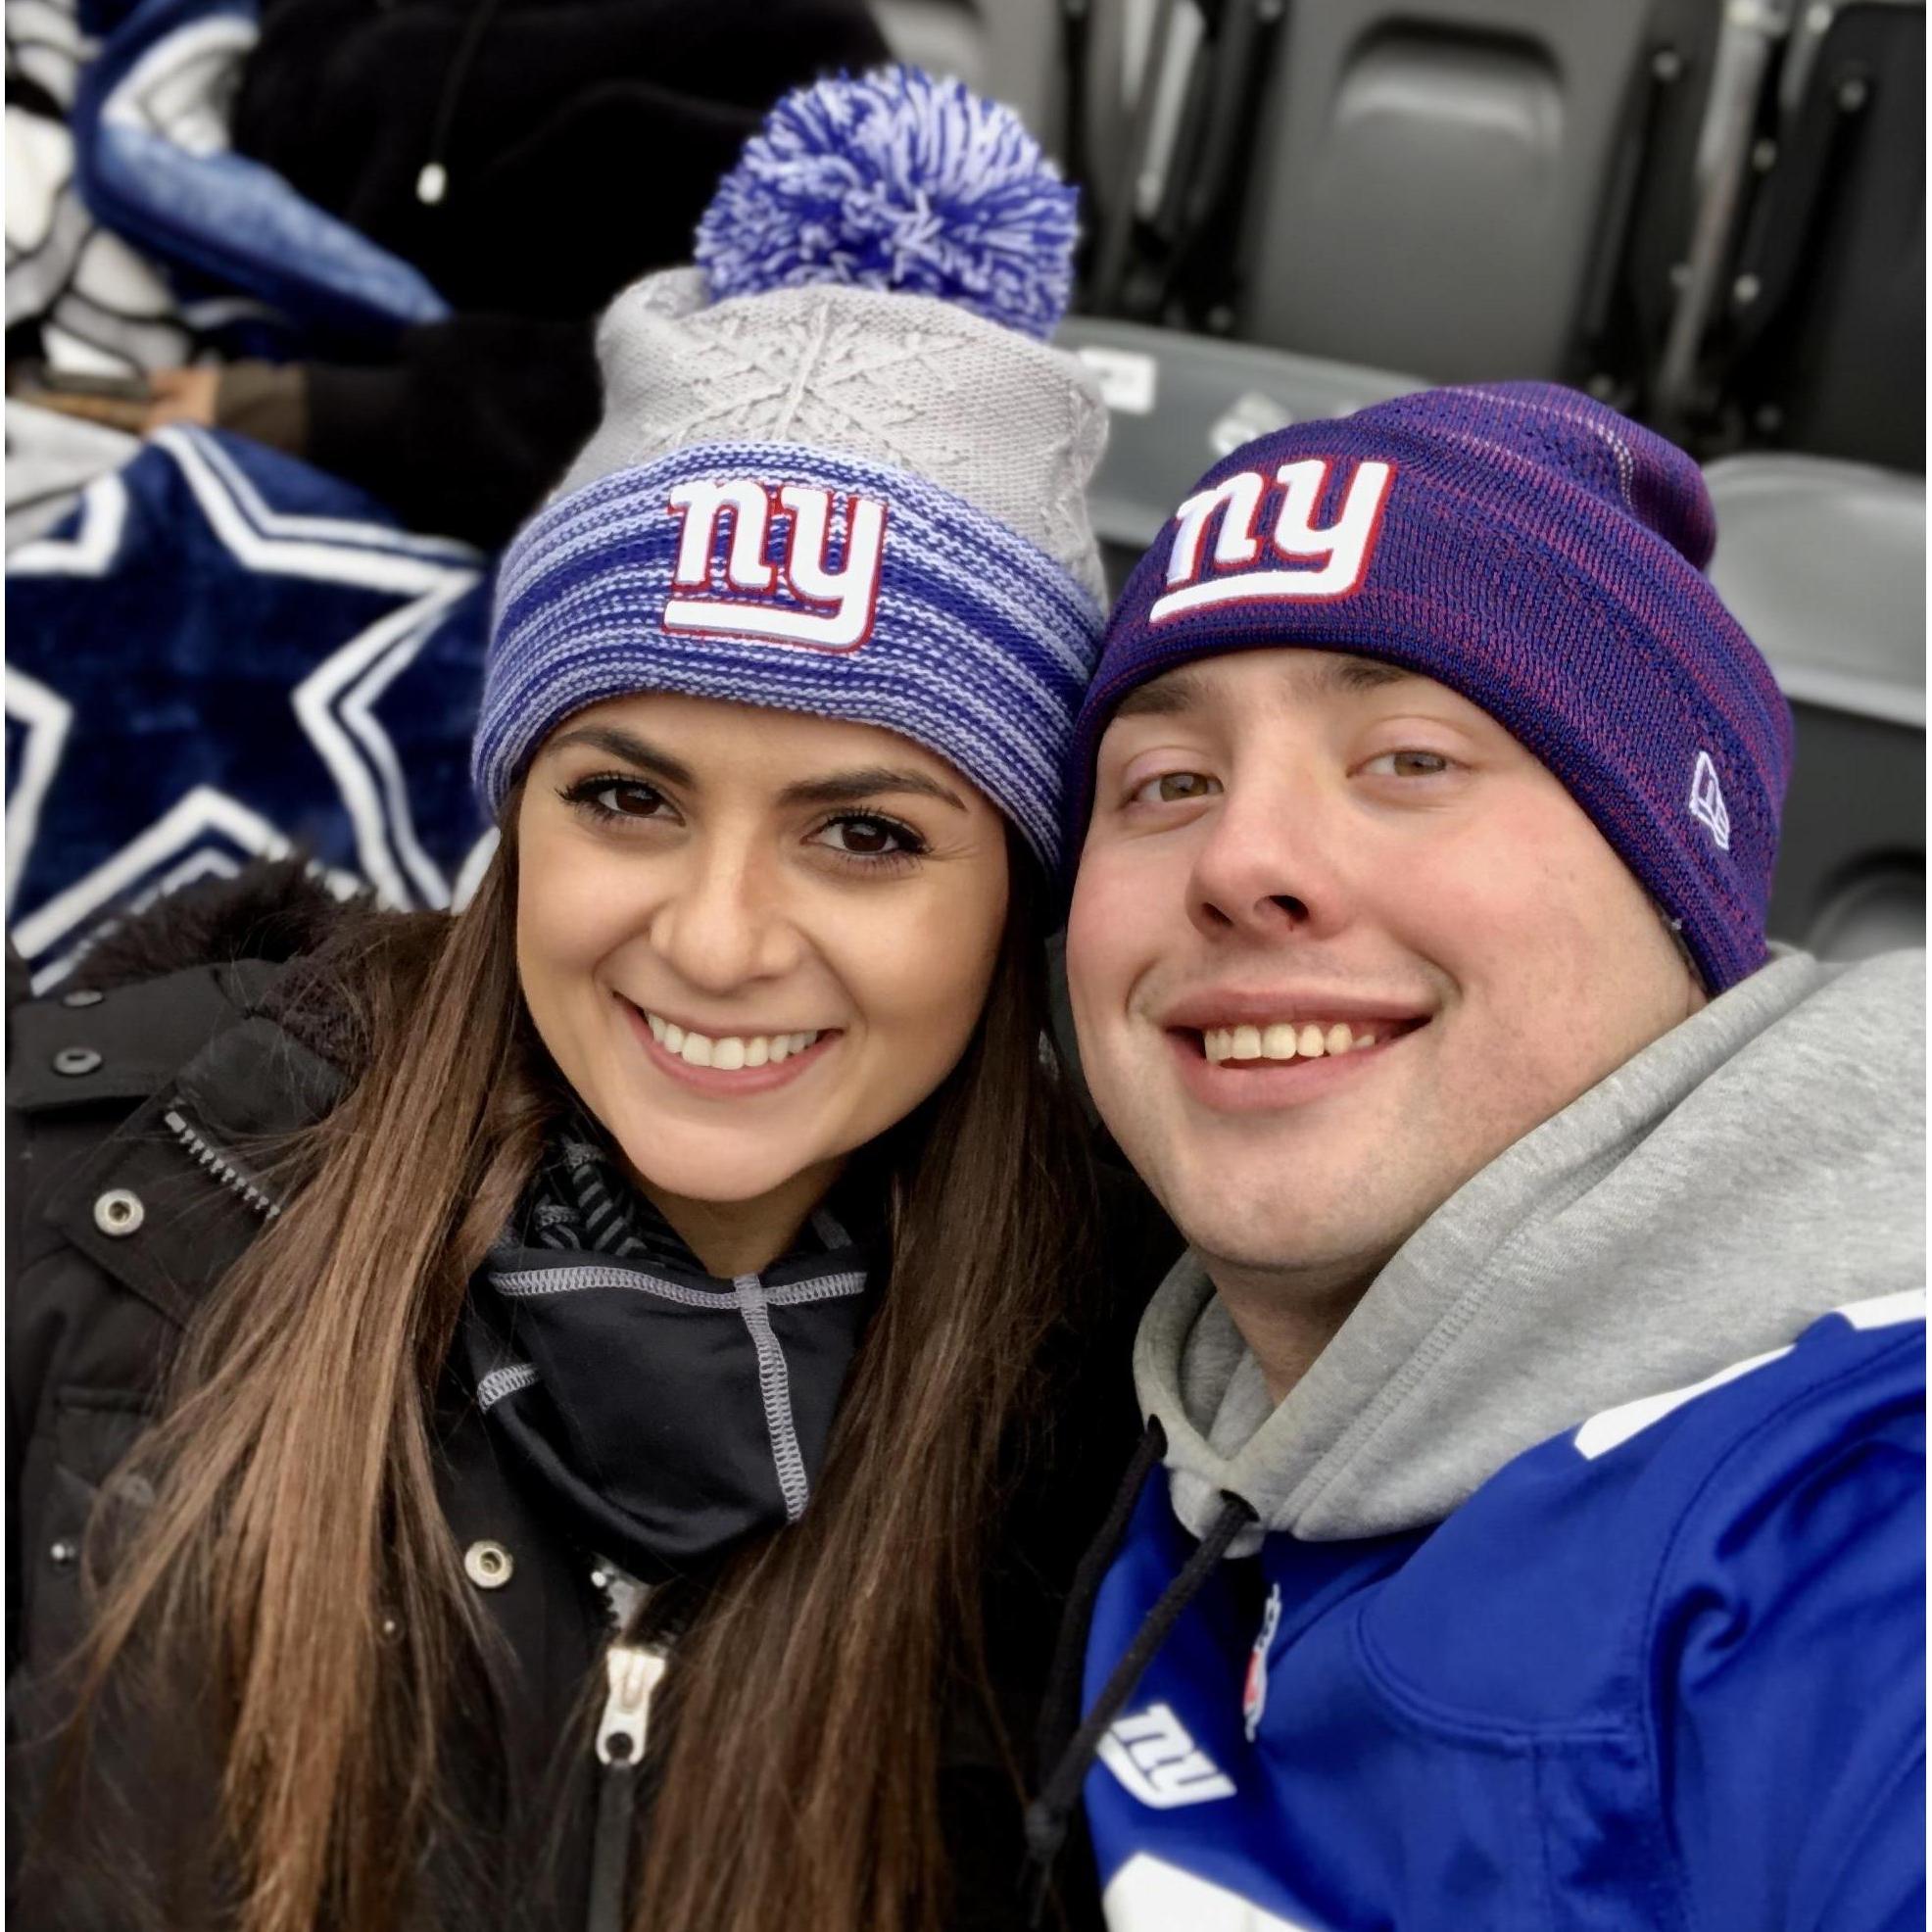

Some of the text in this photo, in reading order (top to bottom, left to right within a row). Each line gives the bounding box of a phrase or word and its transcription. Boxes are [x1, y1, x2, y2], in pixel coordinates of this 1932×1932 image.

[663, 478, 887, 652] ny
[1149, 458, 1396, 625] ny
[1096, 1704, 1236, 1810] ny
